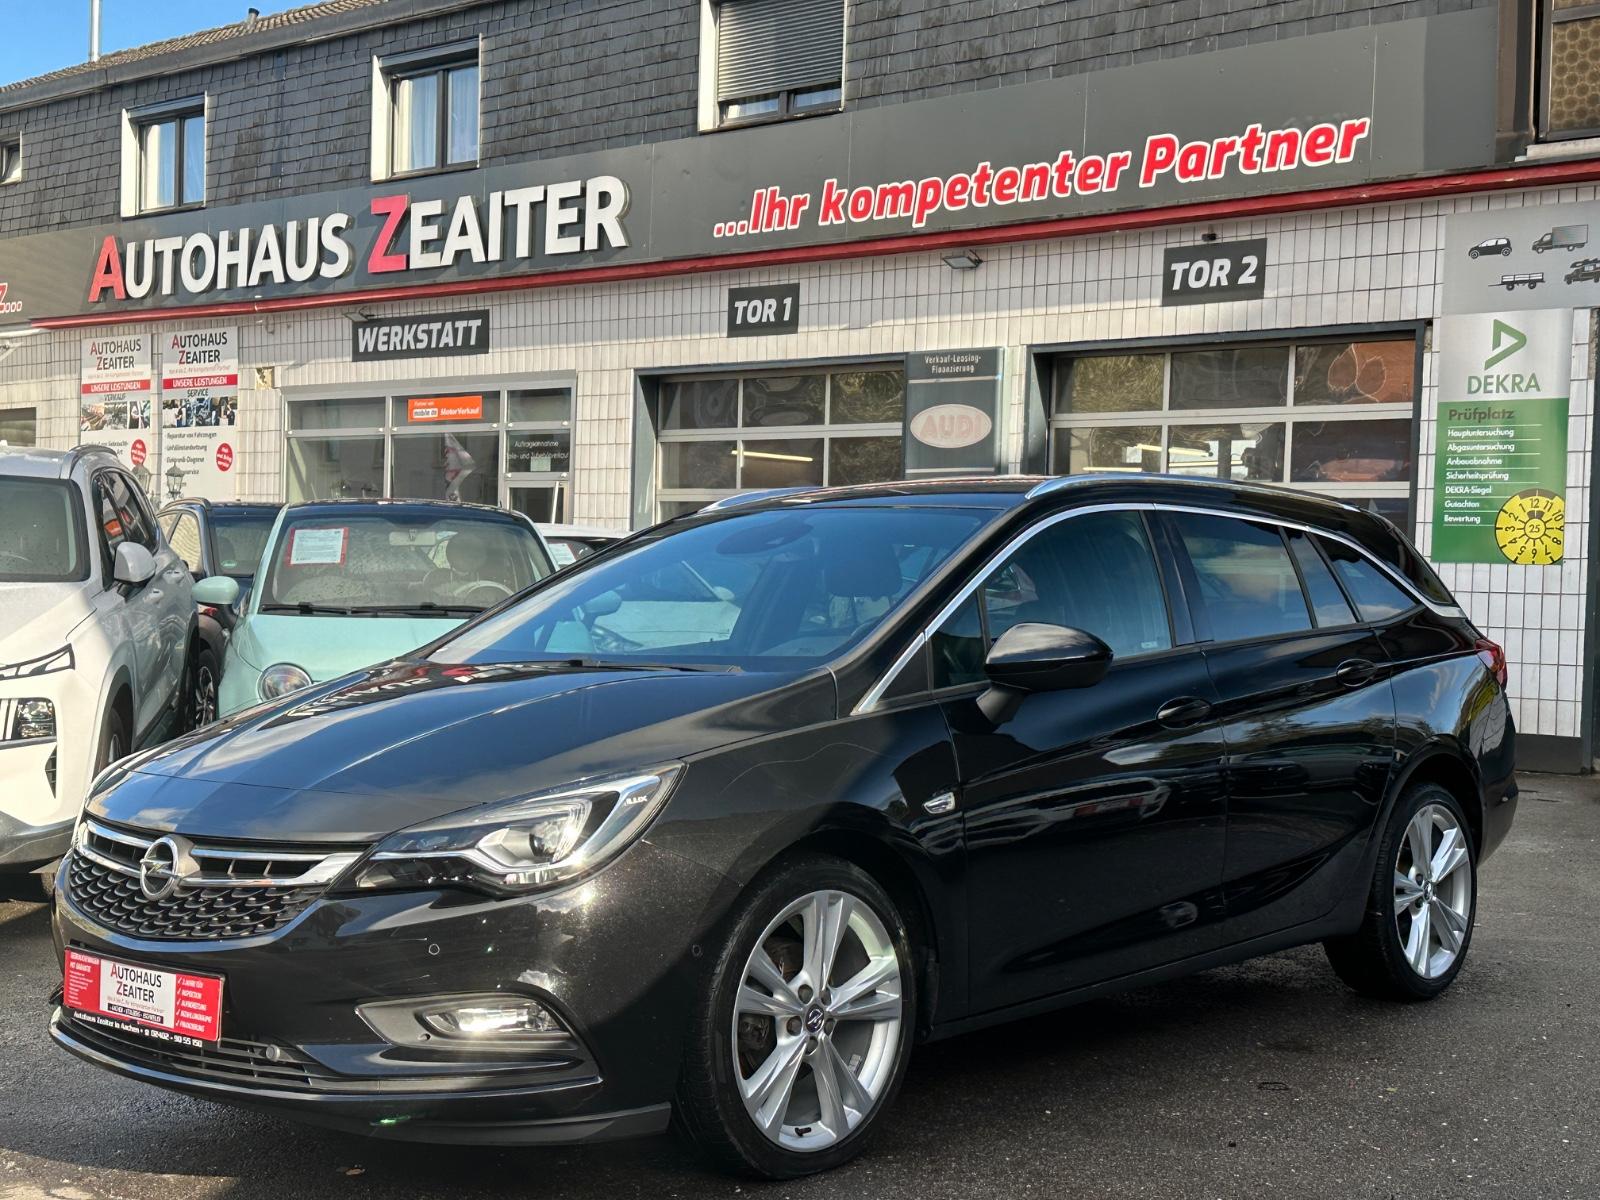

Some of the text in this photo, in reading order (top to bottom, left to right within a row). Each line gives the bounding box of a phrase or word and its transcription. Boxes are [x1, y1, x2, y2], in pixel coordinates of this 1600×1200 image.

[818, 149, 1132, 228] kompetenter
[1138, 116, 1370, 188] Partner
[88, 174, 632, 303] AUTOHAUS ZEAITER
[1169, 254, 1258, 291] TOR 2
[732, 296, 794, 325] TOR 1
[171, 331, 228, 350] AUTOHAUS
[356, 318, 483, 353] WERKSTATT
[90, 338, 142, 356] AUTOHAUS
[96, 355, 135, 371] ZEAITER
[178, 349, 221, 365] ZEAITER
[1467, 372, 1541, 395] DEKRA
[1448, 407, 1515, 423] Prüfplatz
[920, 413, 983, 439] AUDI
[1447, 428, 1514, 438] Hauptuntersuchung
[1447, 443, 1515, 453] Abgasuntersuchung
[1446, 457, 1503, 466] Anbauabnahme
[1445, 471, 1510, 481] Sicherheitsprüfung
[1445, 485, 1492, 495] DEKRA-Siegel
[1444, 500, 1480, 509] Gutachten
[1529, 498, 1540, 509] 12
[1443, 514, 1481, 524] Bewertung
[1508, 512, 1519, 522] 2
[1528, 524, 1541, 533] 25
[1551, 536, 1562, 545] 8
[110, 963, 162, 988] AUTOHAUS
[116, 981, 155, 1003] ZEAITER
